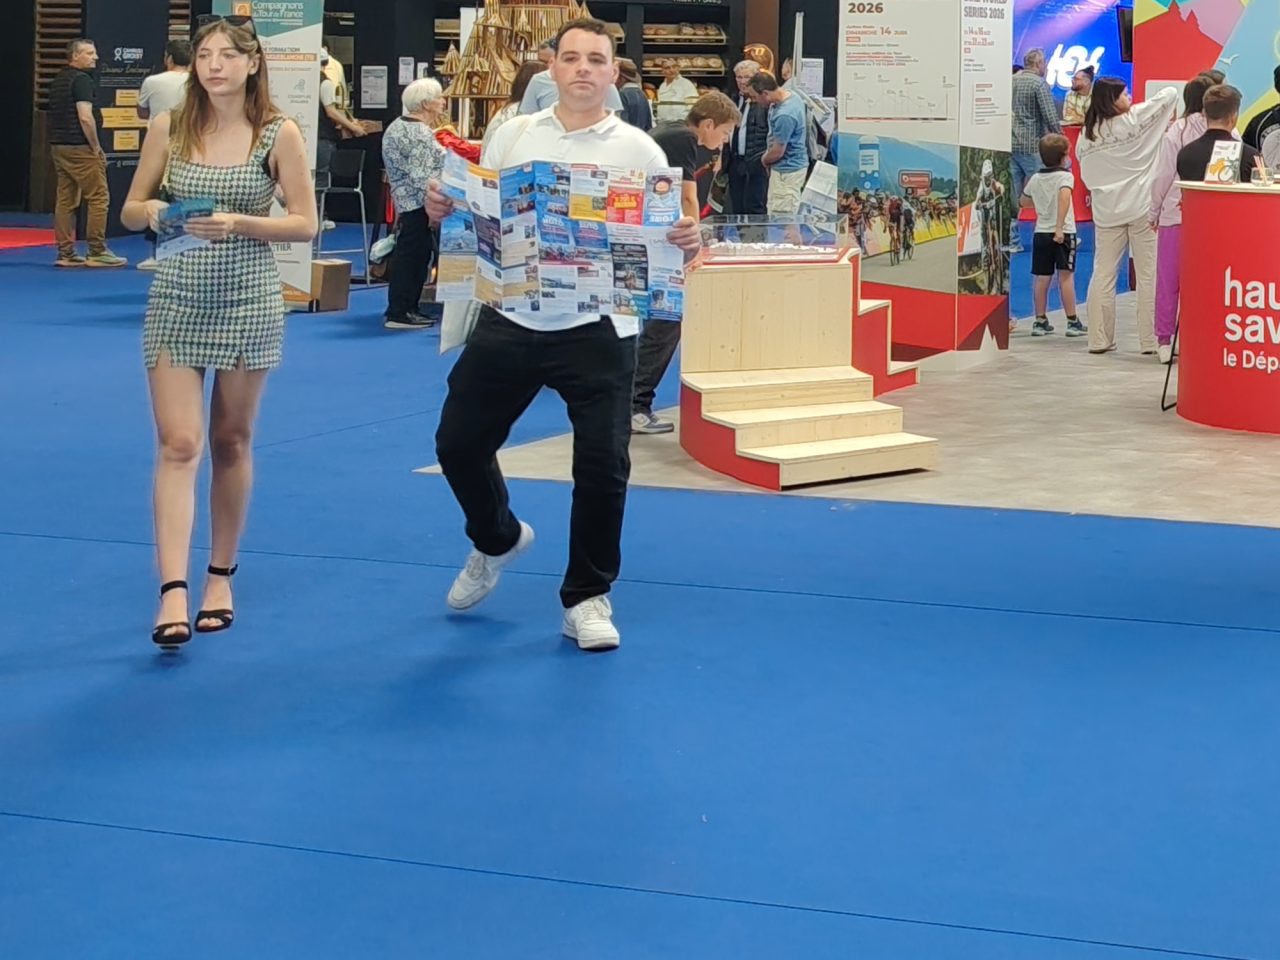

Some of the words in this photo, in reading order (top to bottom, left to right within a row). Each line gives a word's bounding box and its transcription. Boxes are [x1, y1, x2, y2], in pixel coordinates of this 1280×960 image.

[251, 0, 304, 11] Compagnons
[848, 2, 884, 14] 2026
[963, 6, 988, 19] SERIES
[989, 7, 1005, 20] 2026
[880, 26, 892, 36] 14
[1223, 347, 1237, 367] le
